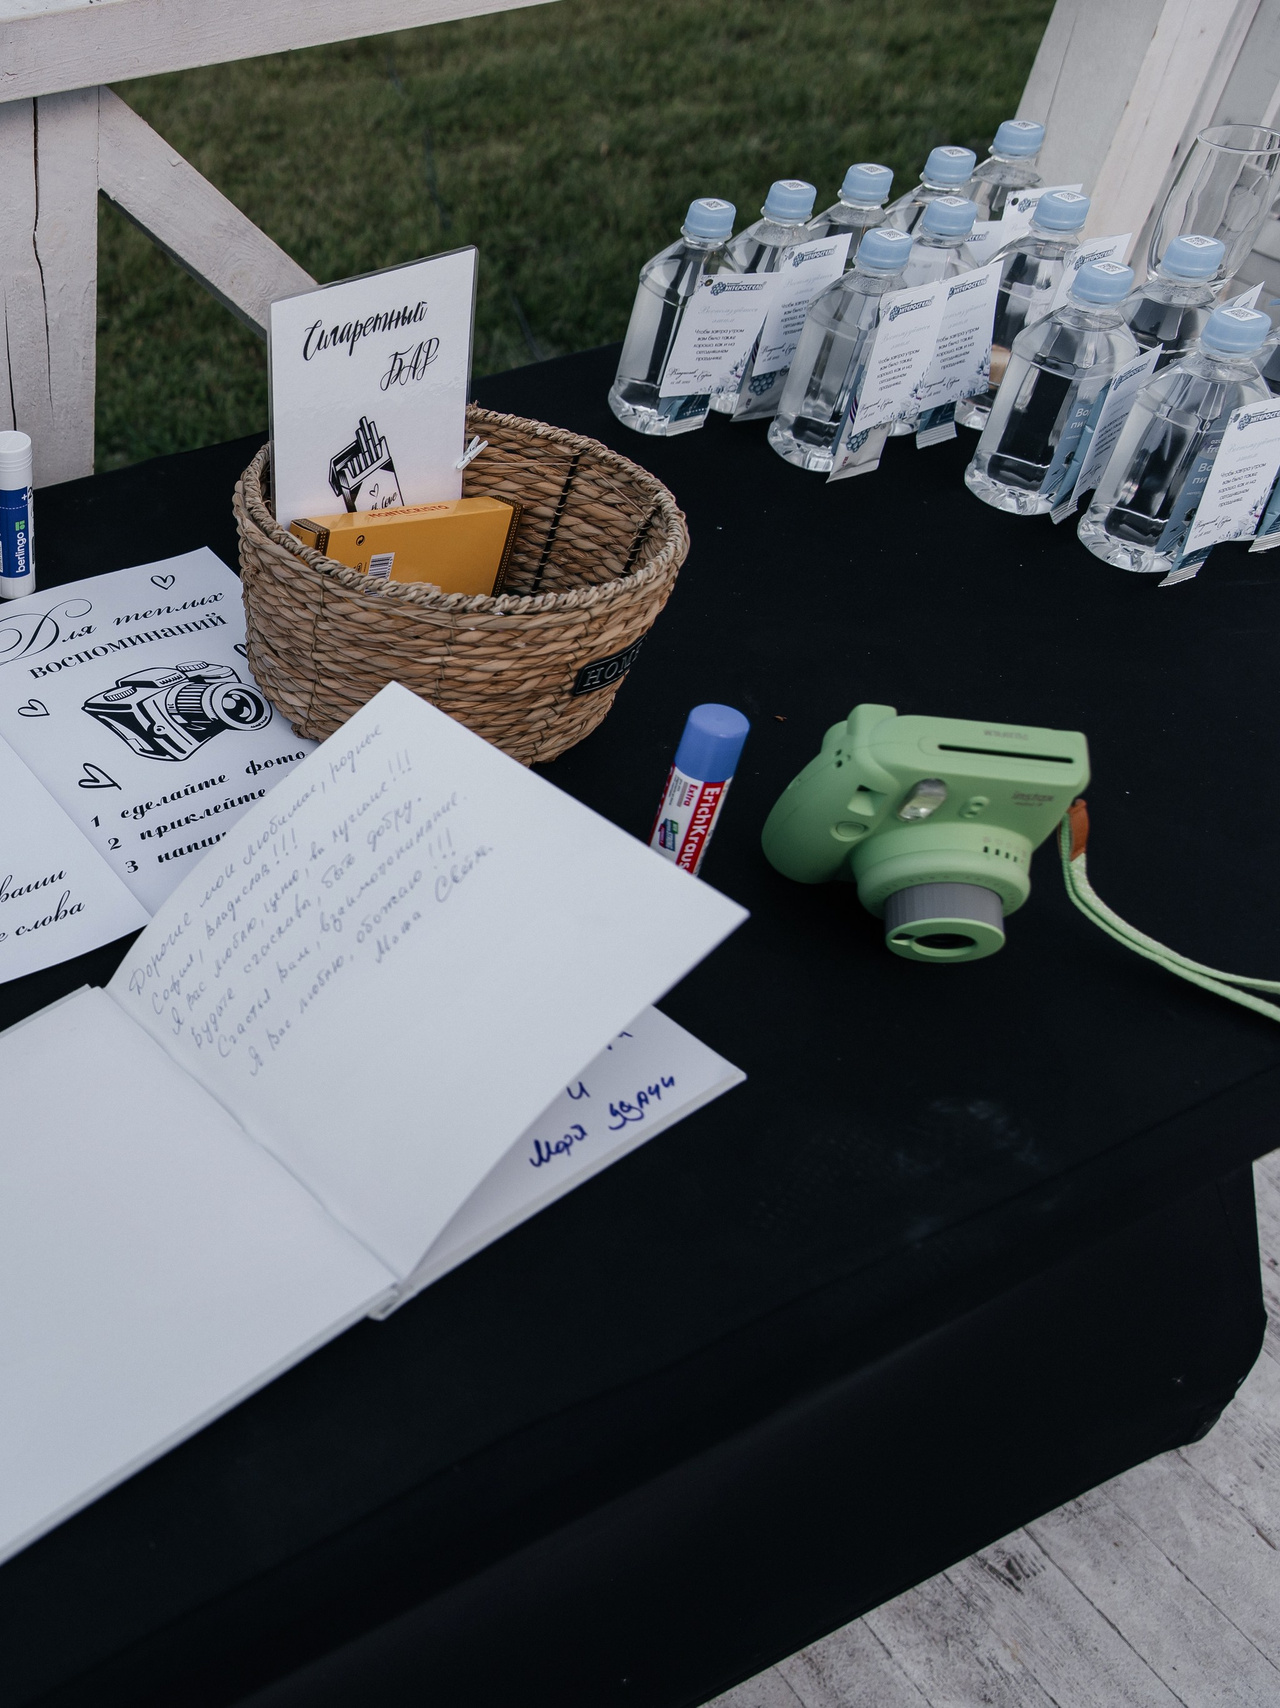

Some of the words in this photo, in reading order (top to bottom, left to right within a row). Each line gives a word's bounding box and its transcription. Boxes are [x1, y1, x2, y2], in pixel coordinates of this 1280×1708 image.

[303, 301, 427, 361] Сигаретный
[380, 337, 440, 391] БАР
[15, 532, 26, 573] berlingo
[113, 592, 224, 626] теплых
[28, 612, 228, 679] воспоминаний
[91, 815, 101, 828] 1
[121, 774, 230, 819] сделайте
[108, 837, 122, 850] 2
[140, 788, 266, 840] приклейте
[125, 860, 139, 874] 3
[15, 890, 85, 936] слова
